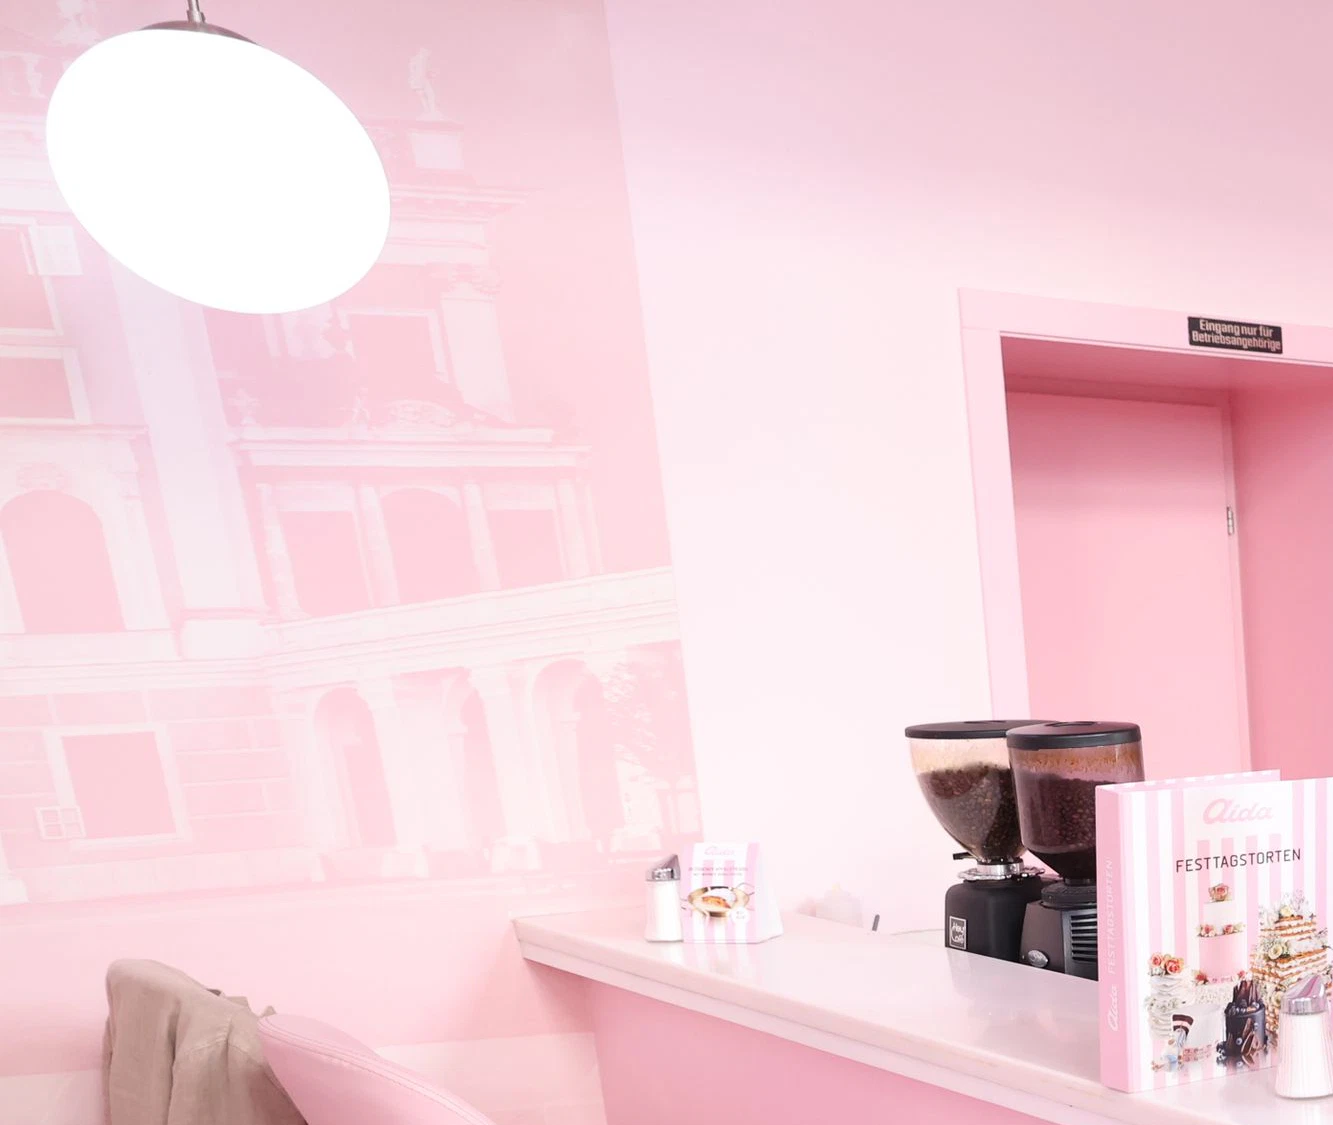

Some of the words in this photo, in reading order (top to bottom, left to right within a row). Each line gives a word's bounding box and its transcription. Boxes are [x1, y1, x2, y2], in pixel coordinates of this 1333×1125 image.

[1199, 319, 1240, 336] Eingang
[1241, 326, 1258, 335] nur
[1259, 325, 1273, 337] für
[1191, 330, 1281, 351] Betriebsangehörige
[1175, 848, 1302, 873] FESTTAGSTORTEN
